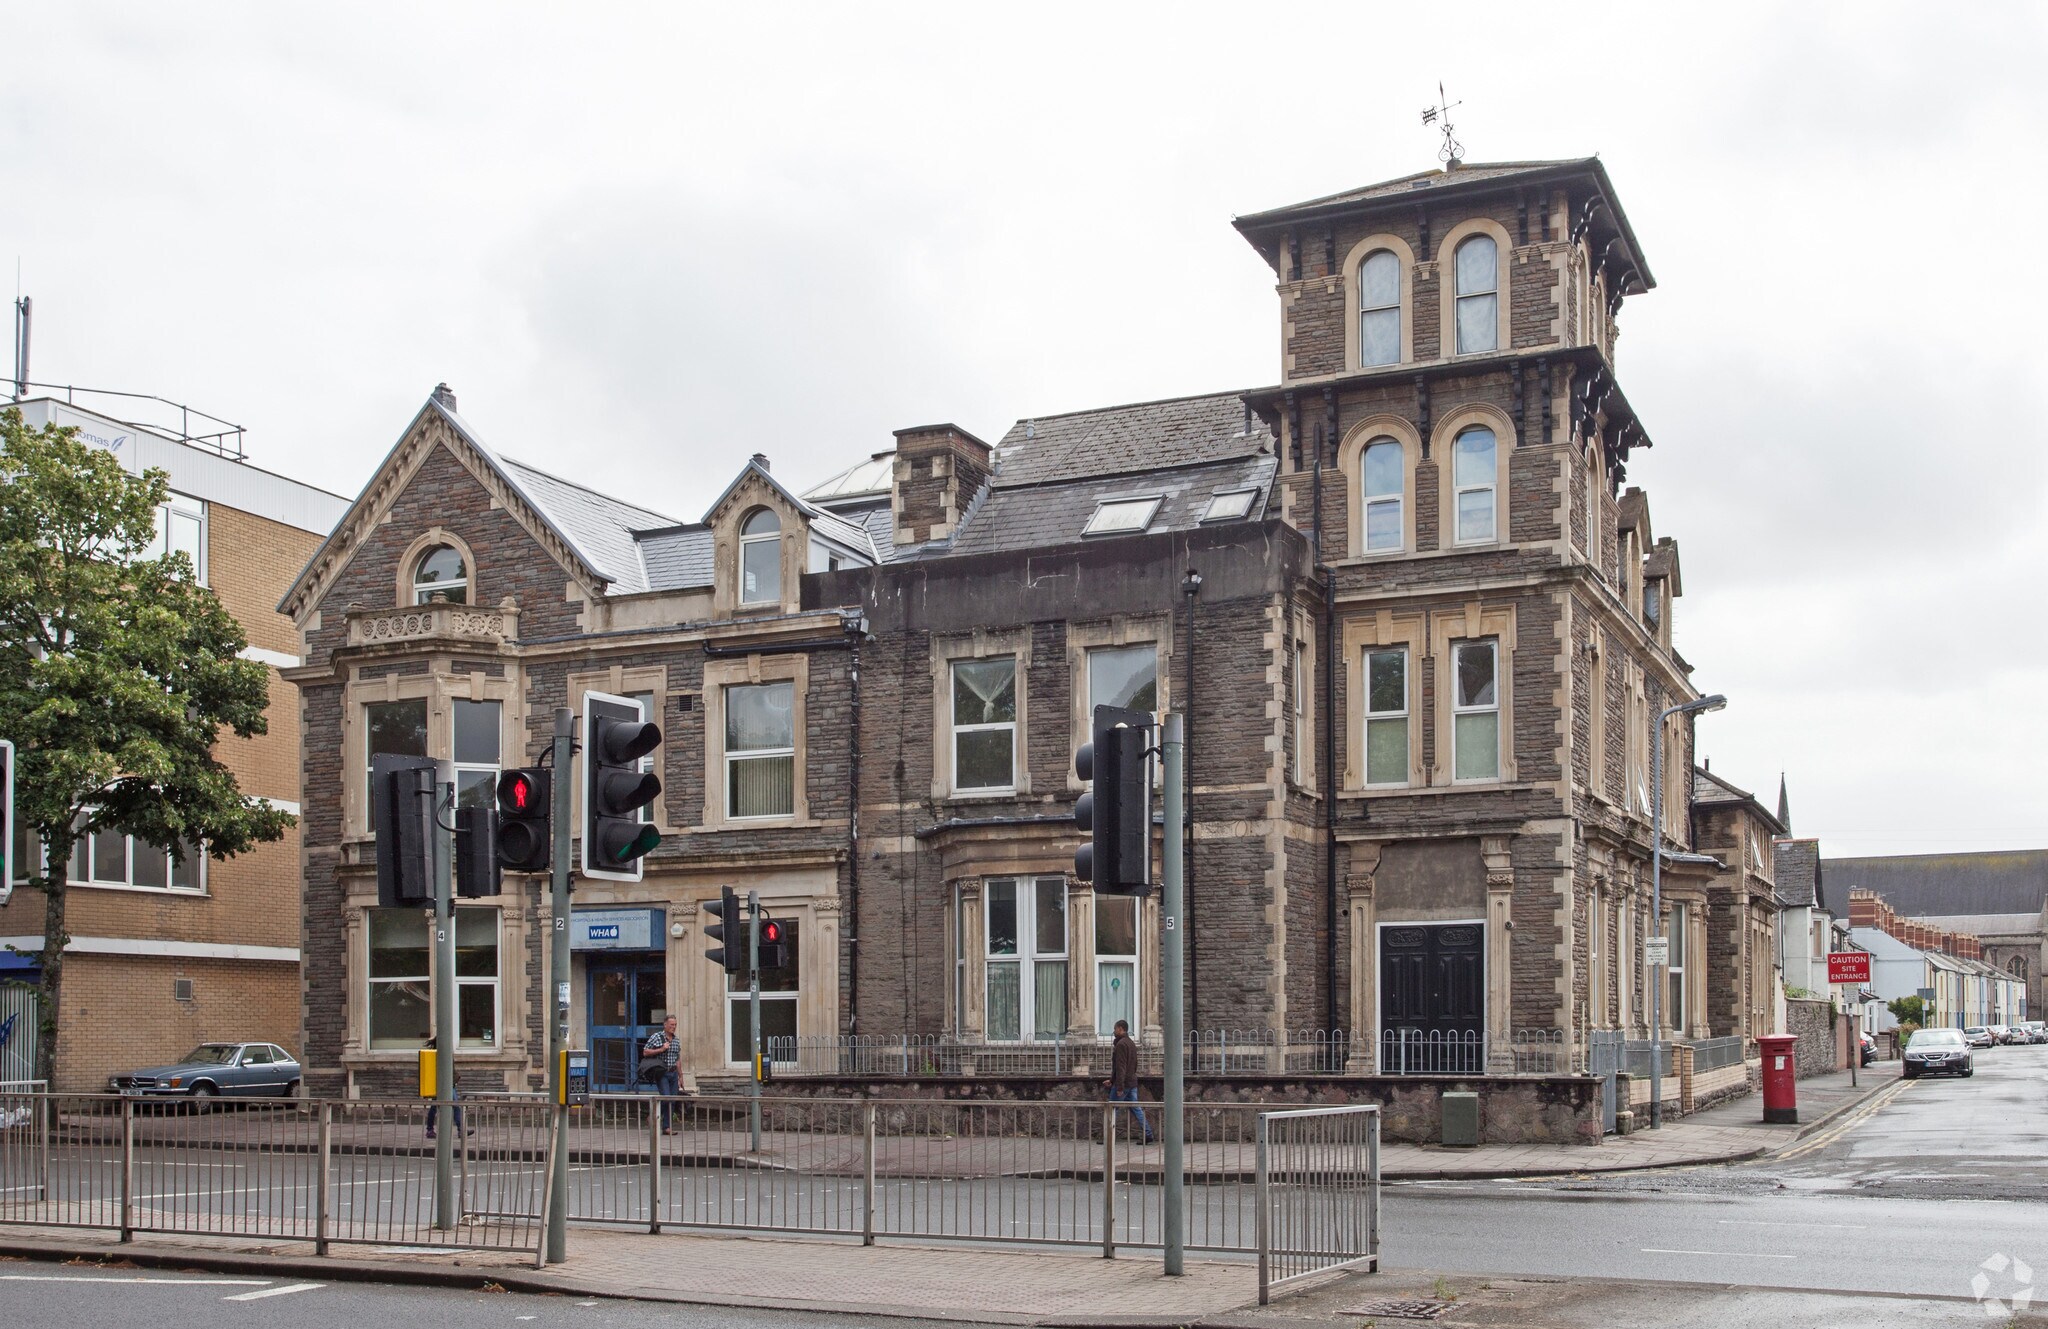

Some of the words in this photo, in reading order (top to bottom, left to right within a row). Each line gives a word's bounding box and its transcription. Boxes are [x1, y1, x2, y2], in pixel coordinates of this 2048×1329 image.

[557, 919, 564, 929] 2
[1167, 918, 1173, 928] 5
[438, 932, 444, 940] 4
[590, 928, 610, 937] WHA
[570, 1068, 586, 1076] WAIT
